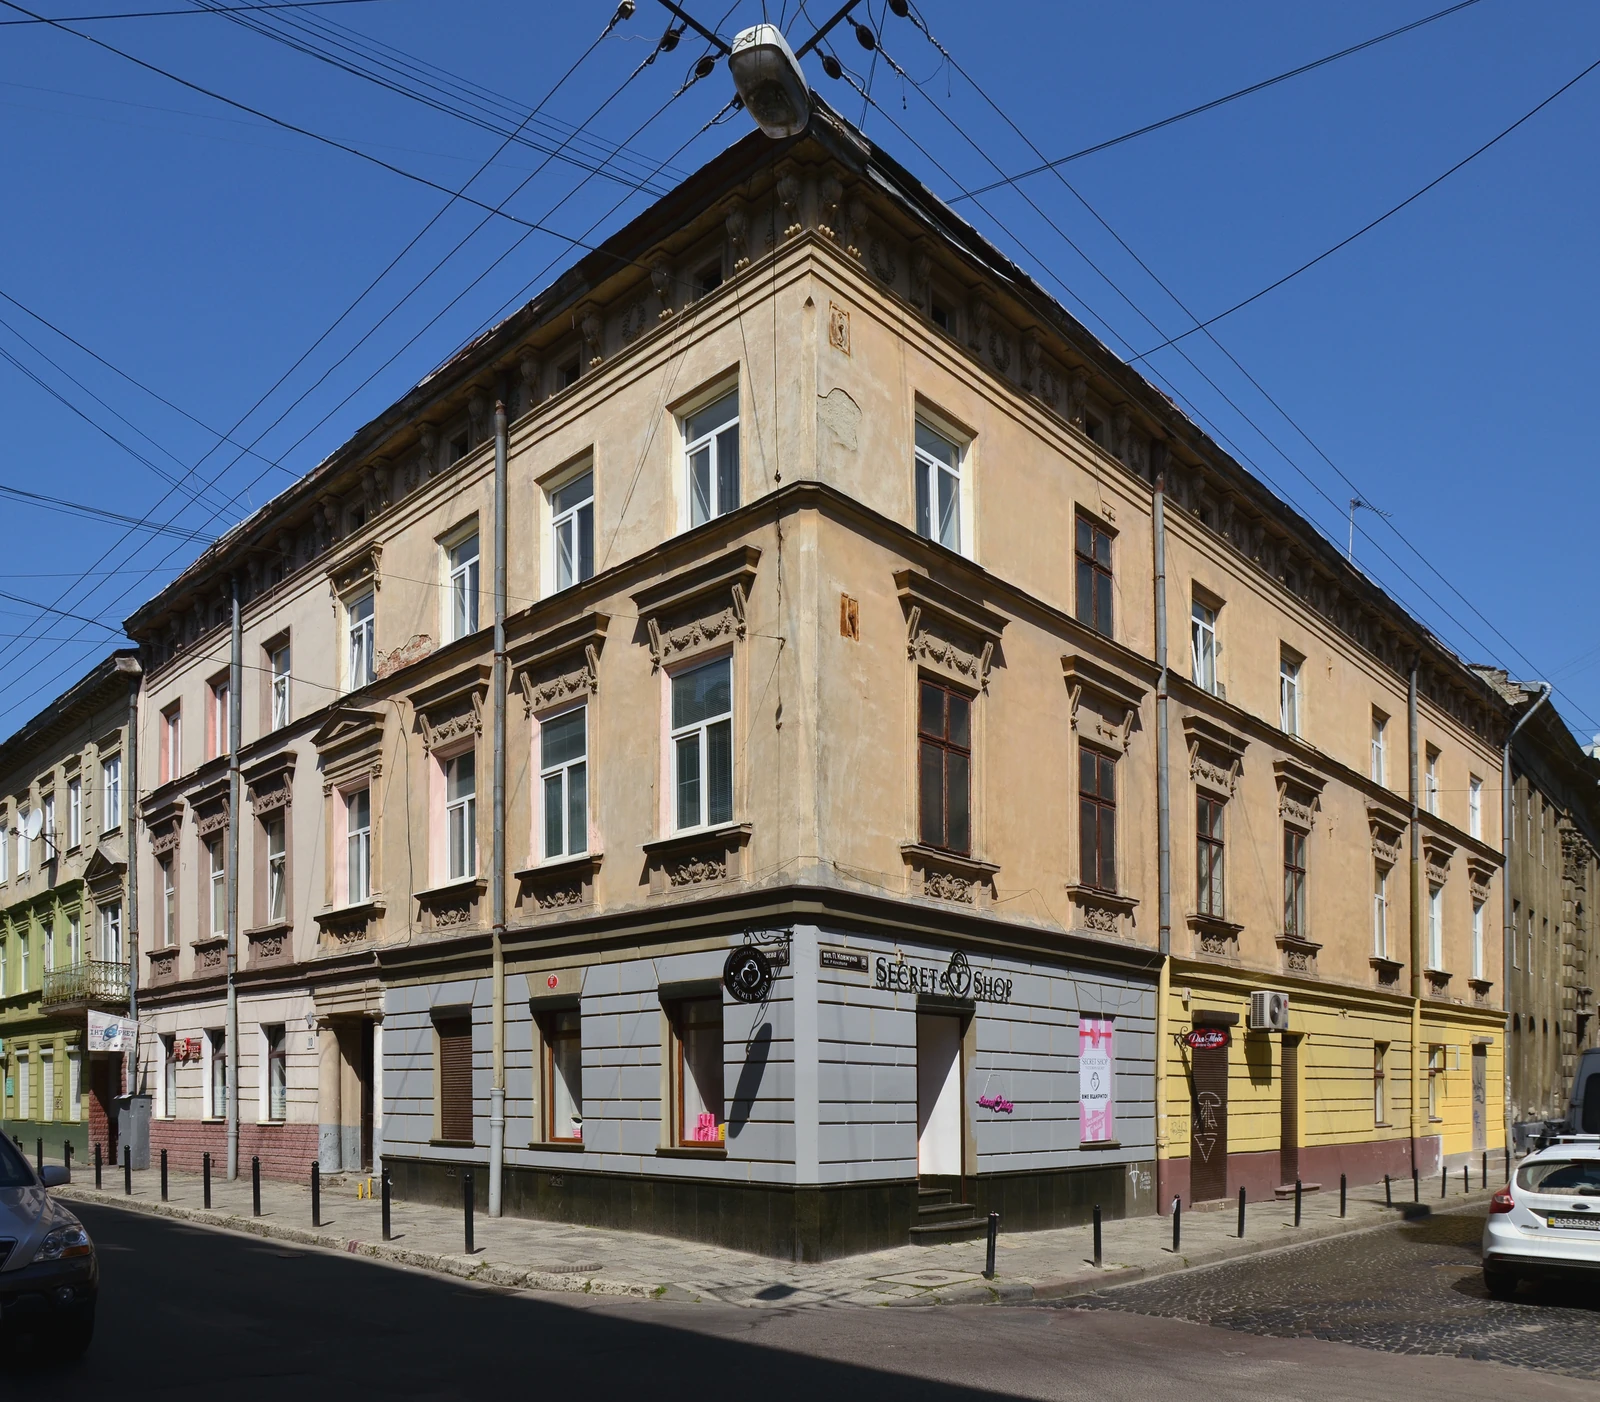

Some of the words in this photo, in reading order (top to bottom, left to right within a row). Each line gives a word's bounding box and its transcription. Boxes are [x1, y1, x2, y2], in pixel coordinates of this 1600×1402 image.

[876, 957, 938, 989] SECRET
[974, 971, 1013, 998] SHOP
[731, 981, 753, 1000] SECRET
[754, 981, 769, 999] SHOP
[1082, 1057, 1096, 1065] SECRET
[1097, 1058, 1108, 1066] SHOP
